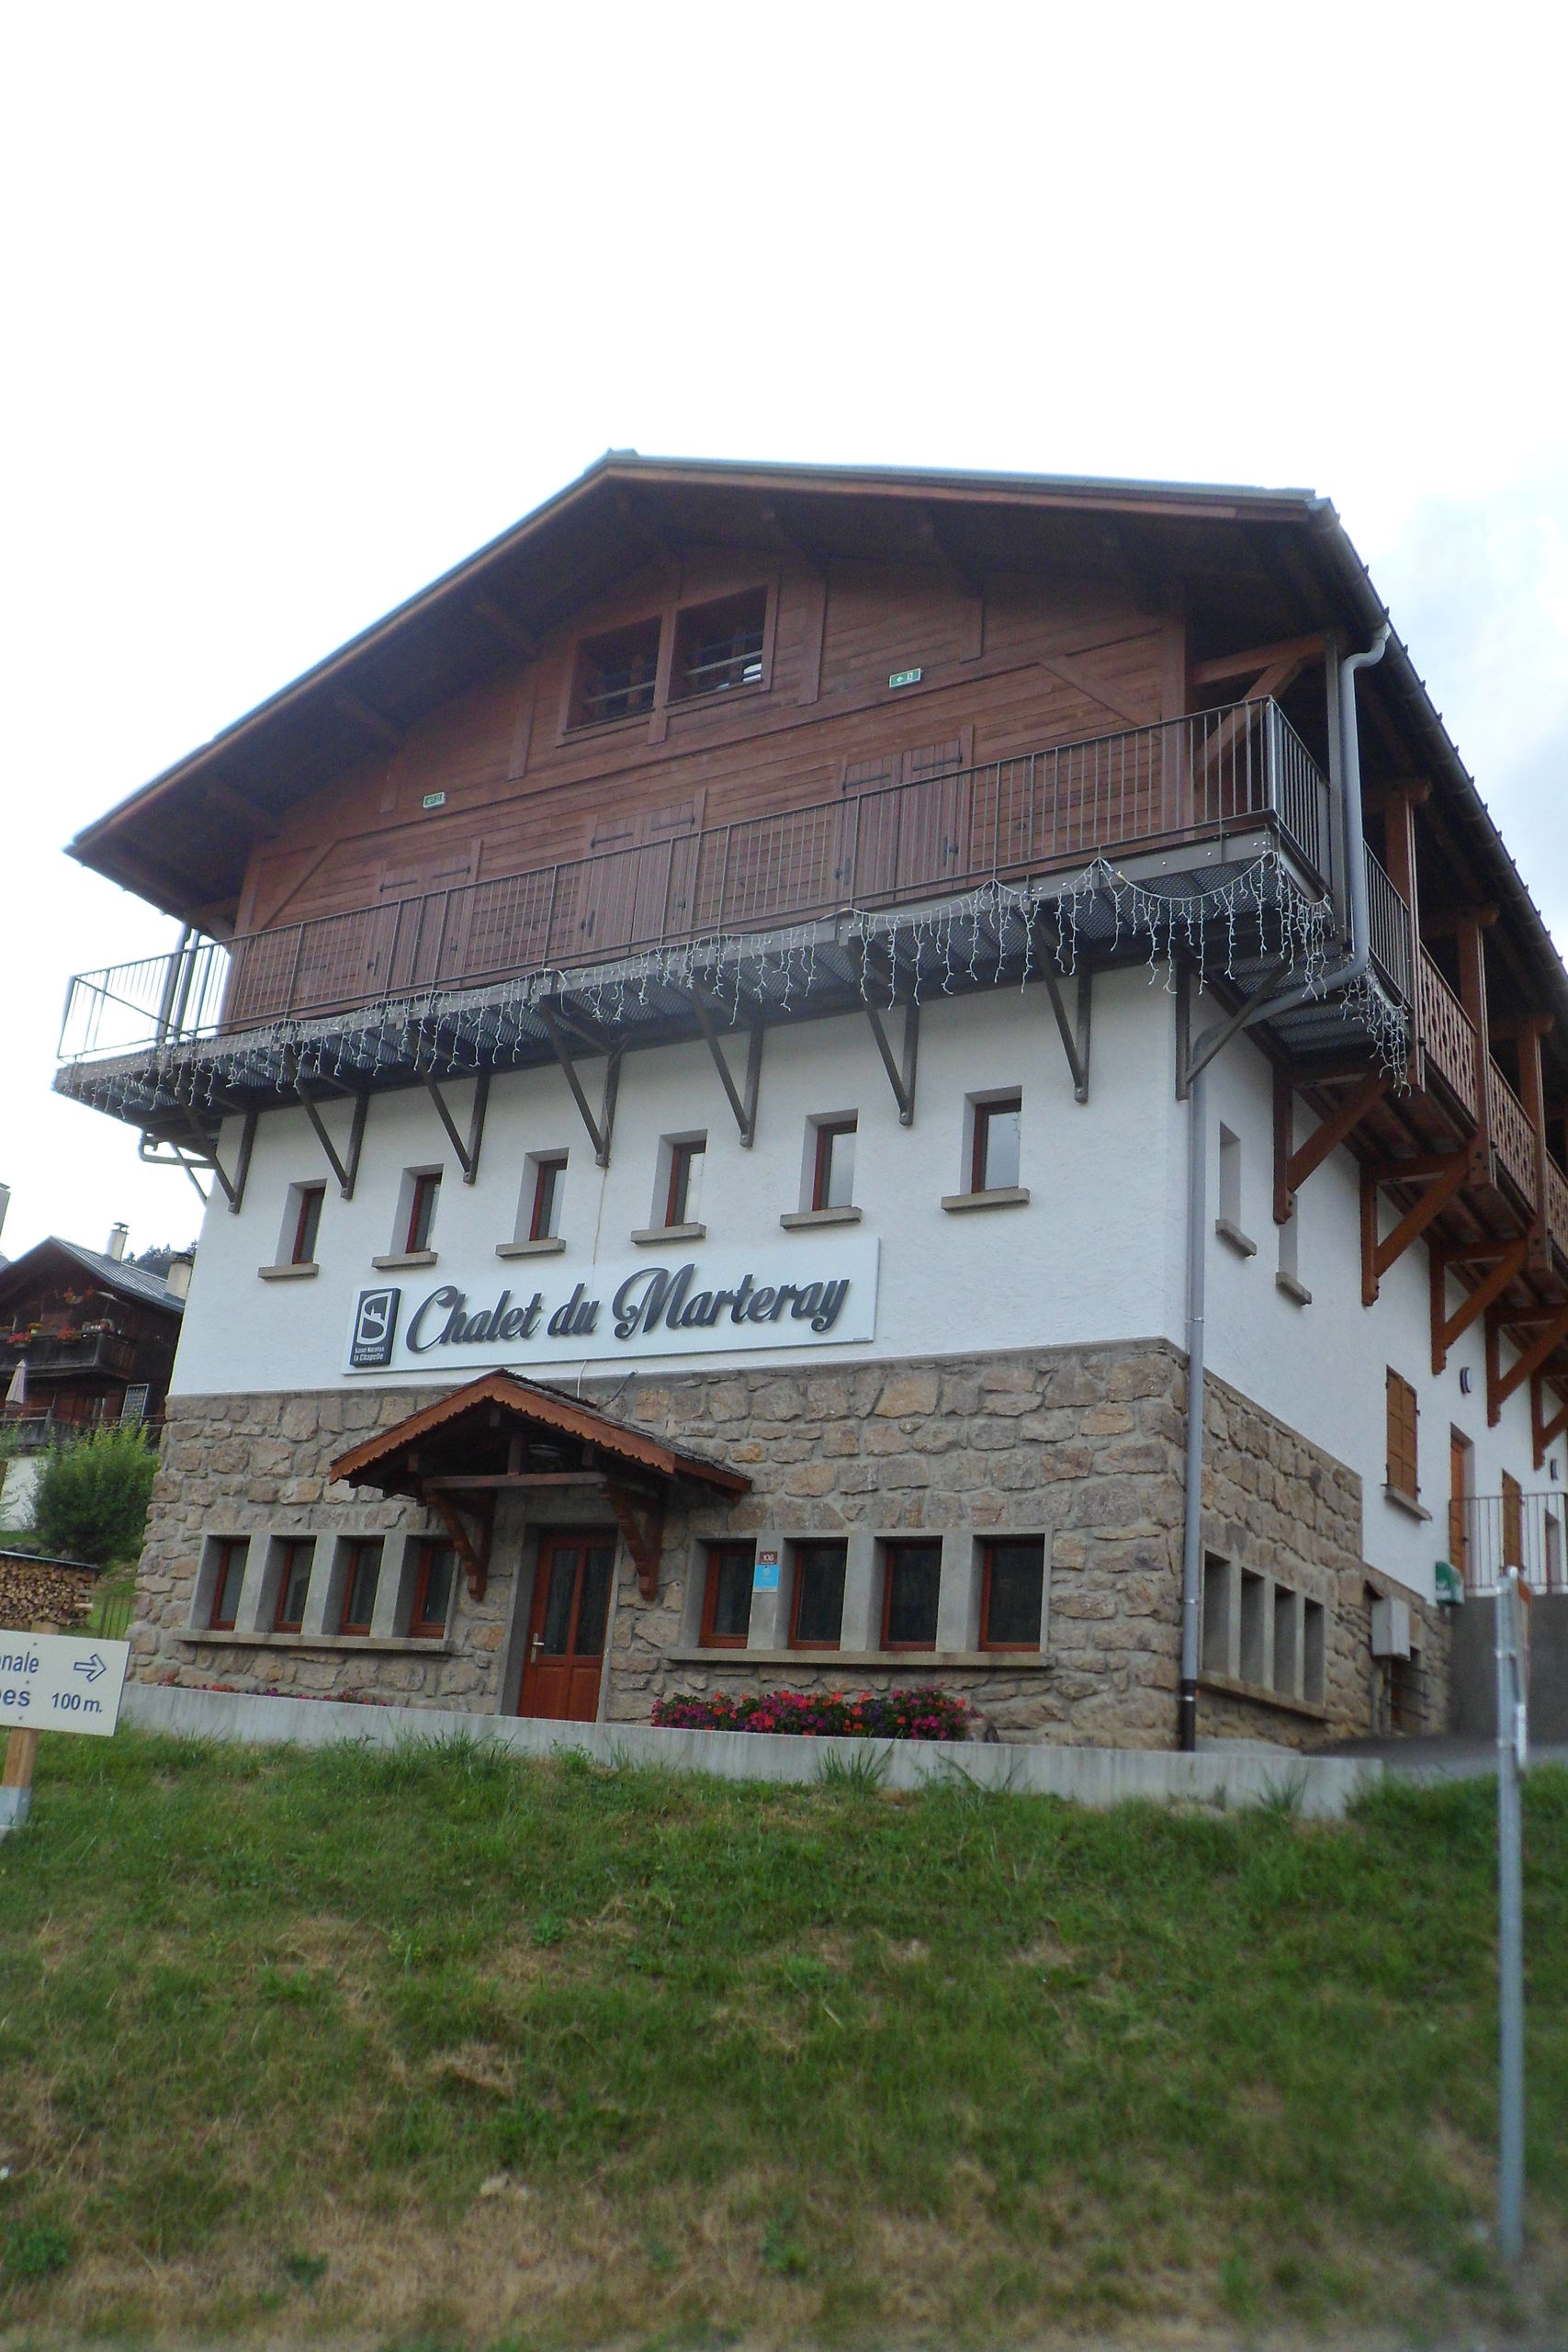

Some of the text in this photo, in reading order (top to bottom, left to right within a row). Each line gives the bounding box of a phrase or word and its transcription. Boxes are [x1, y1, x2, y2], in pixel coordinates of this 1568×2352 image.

[405, 1263, 852, 1353] Chalet du Marteray
[359, 1353, 384, 1362] Chapelle
[0, 1651, 39, 1673] nale
[0, 1689, 31, 1707] es
[51, 1692, 81, 1711] 100
